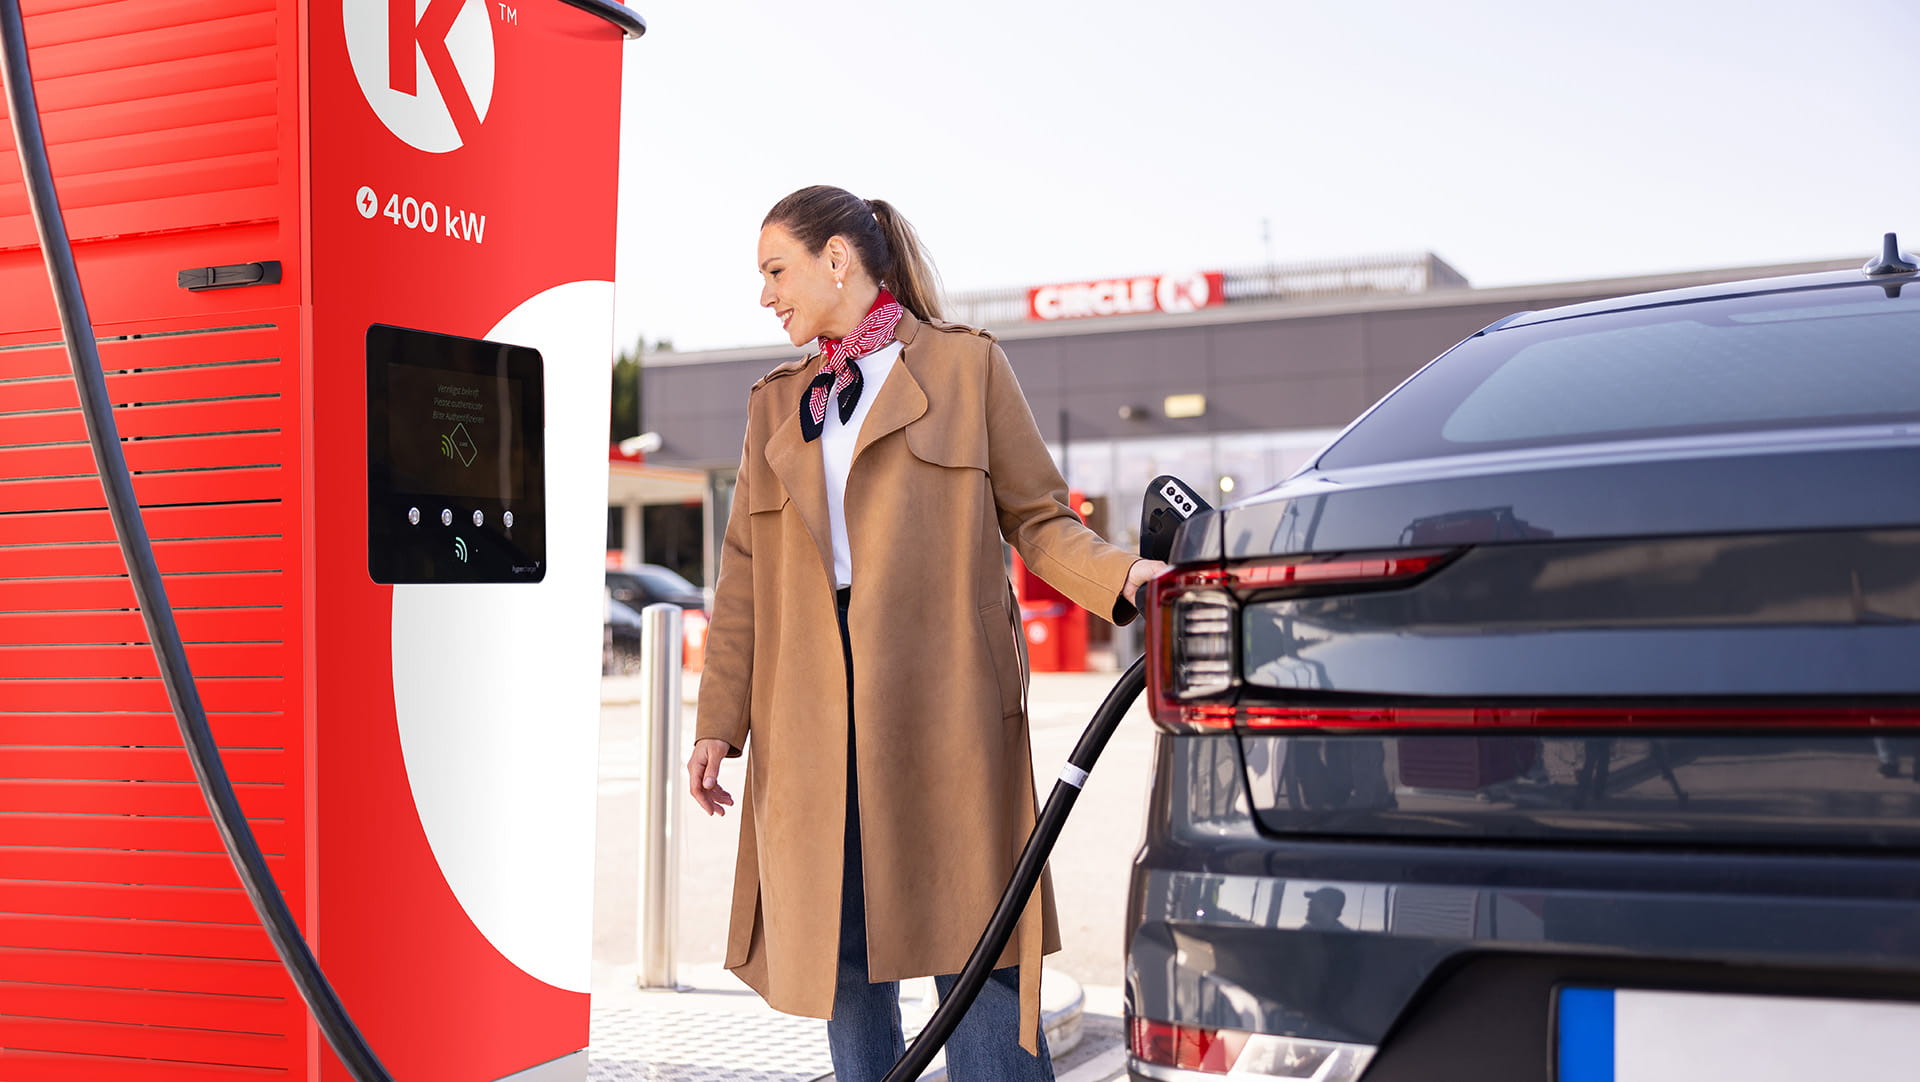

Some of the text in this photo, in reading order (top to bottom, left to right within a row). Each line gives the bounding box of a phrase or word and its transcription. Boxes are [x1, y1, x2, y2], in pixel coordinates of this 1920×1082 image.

[384, 0, 517, 149] K TM
[383, 193, 486, 244] 400 kW
[1034, 279, 1156, 320] CIRCLE
